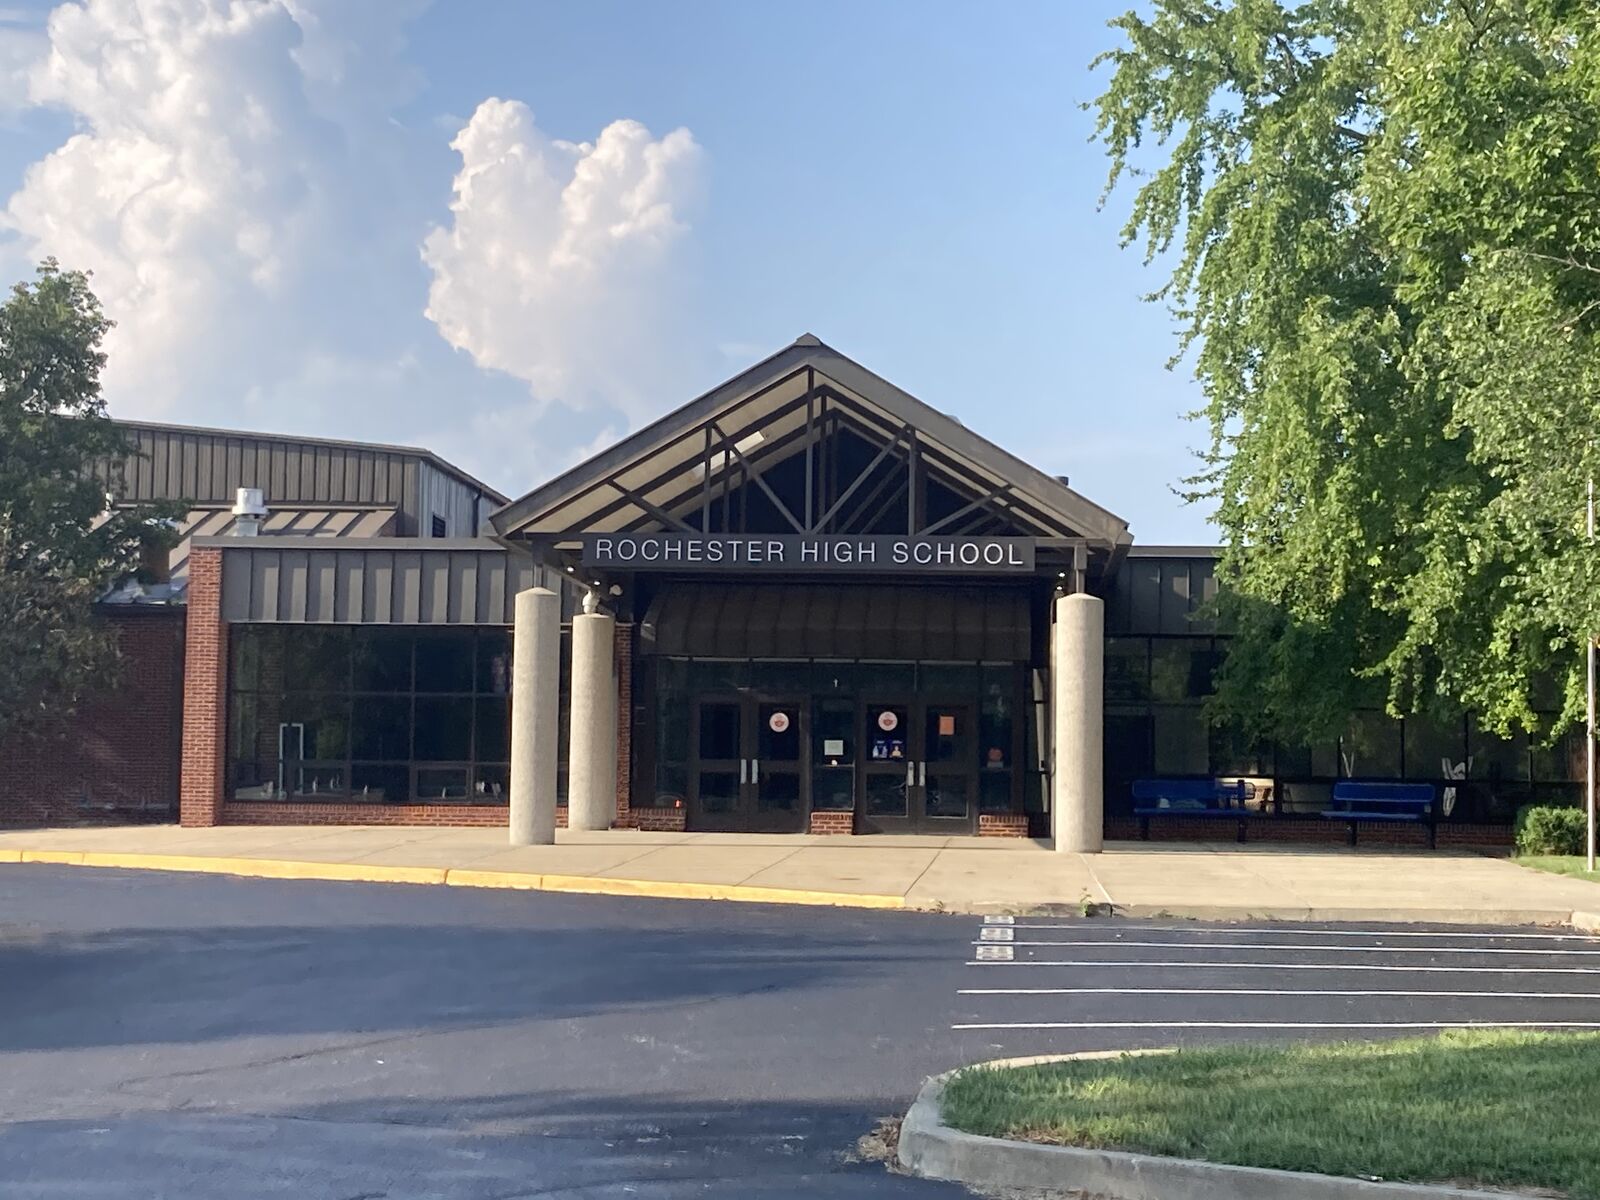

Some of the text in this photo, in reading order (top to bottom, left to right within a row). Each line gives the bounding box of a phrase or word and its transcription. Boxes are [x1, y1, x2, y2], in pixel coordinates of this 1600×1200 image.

[595, 539, 1024, 565] ROCHESTER HIGH SCHOOL
